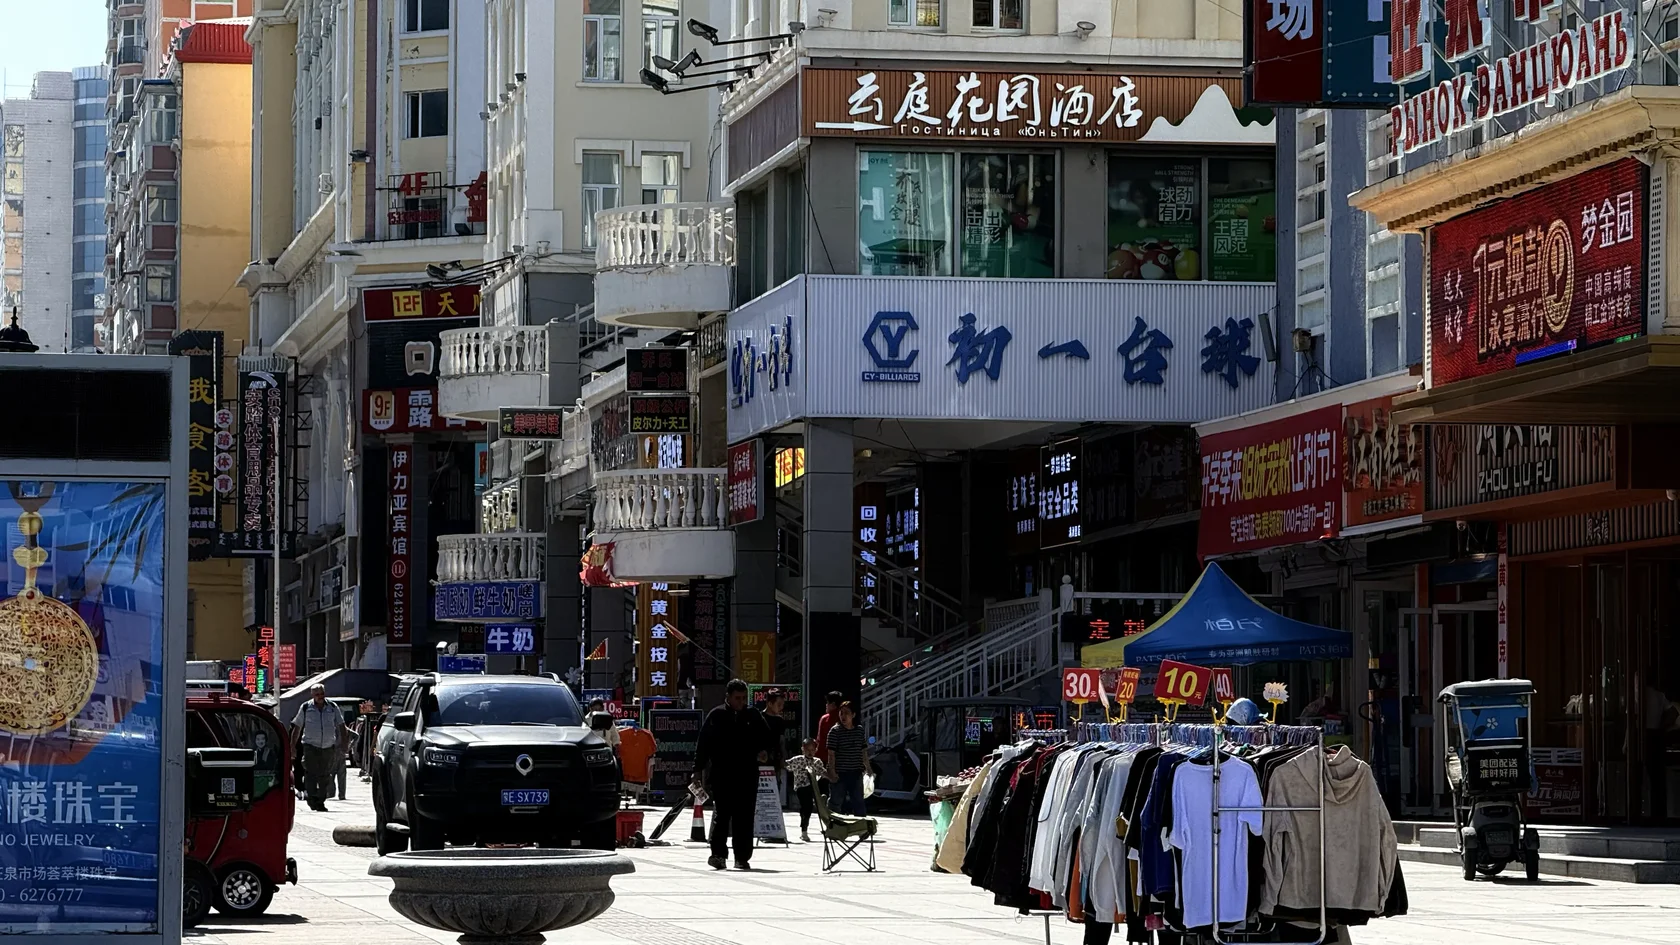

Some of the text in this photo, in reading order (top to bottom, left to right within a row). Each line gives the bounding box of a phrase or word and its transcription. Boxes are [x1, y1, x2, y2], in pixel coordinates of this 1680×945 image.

[1391, 72, 1473, 159] РЫНОК
[1477, 8, 1634, 121] ВАНЦЮАНЬ
[847, 71, 1144, 129] 云庭花园酒店
[900, 123, 1001, 137] Гостиница
[400, 171, 428, 195] 4F
[1214, 219, 1248, 237] 王者
[1581, 190, 1634, 254] 梦金园
[1214, 236, 1248, 253] 风范
[394, 294, 421, 314] 12F
[945, 312, 1261, 388] 初一台球
[863, 372, 919, 382] CY-BILLIARDS
[375, 395, 390, 416] 9F
[632, 417, 688, 430] 皮尔力+天工
[217, 411, 234, 491] 安踏体育
[1478, 459, 1552, 493] ZHOU LIU FU
[392, 450, 407, 555] 伊力亚宾馆
[487, 627, 534, 652] 牛奶
[1480, 758, 1518, 769] 美团配送
[1480, 768, 1518, 779] 准时好用
[0, 781, 138, 824] 楼珠宝
[21, 834, 95, 846] JEWELRY
